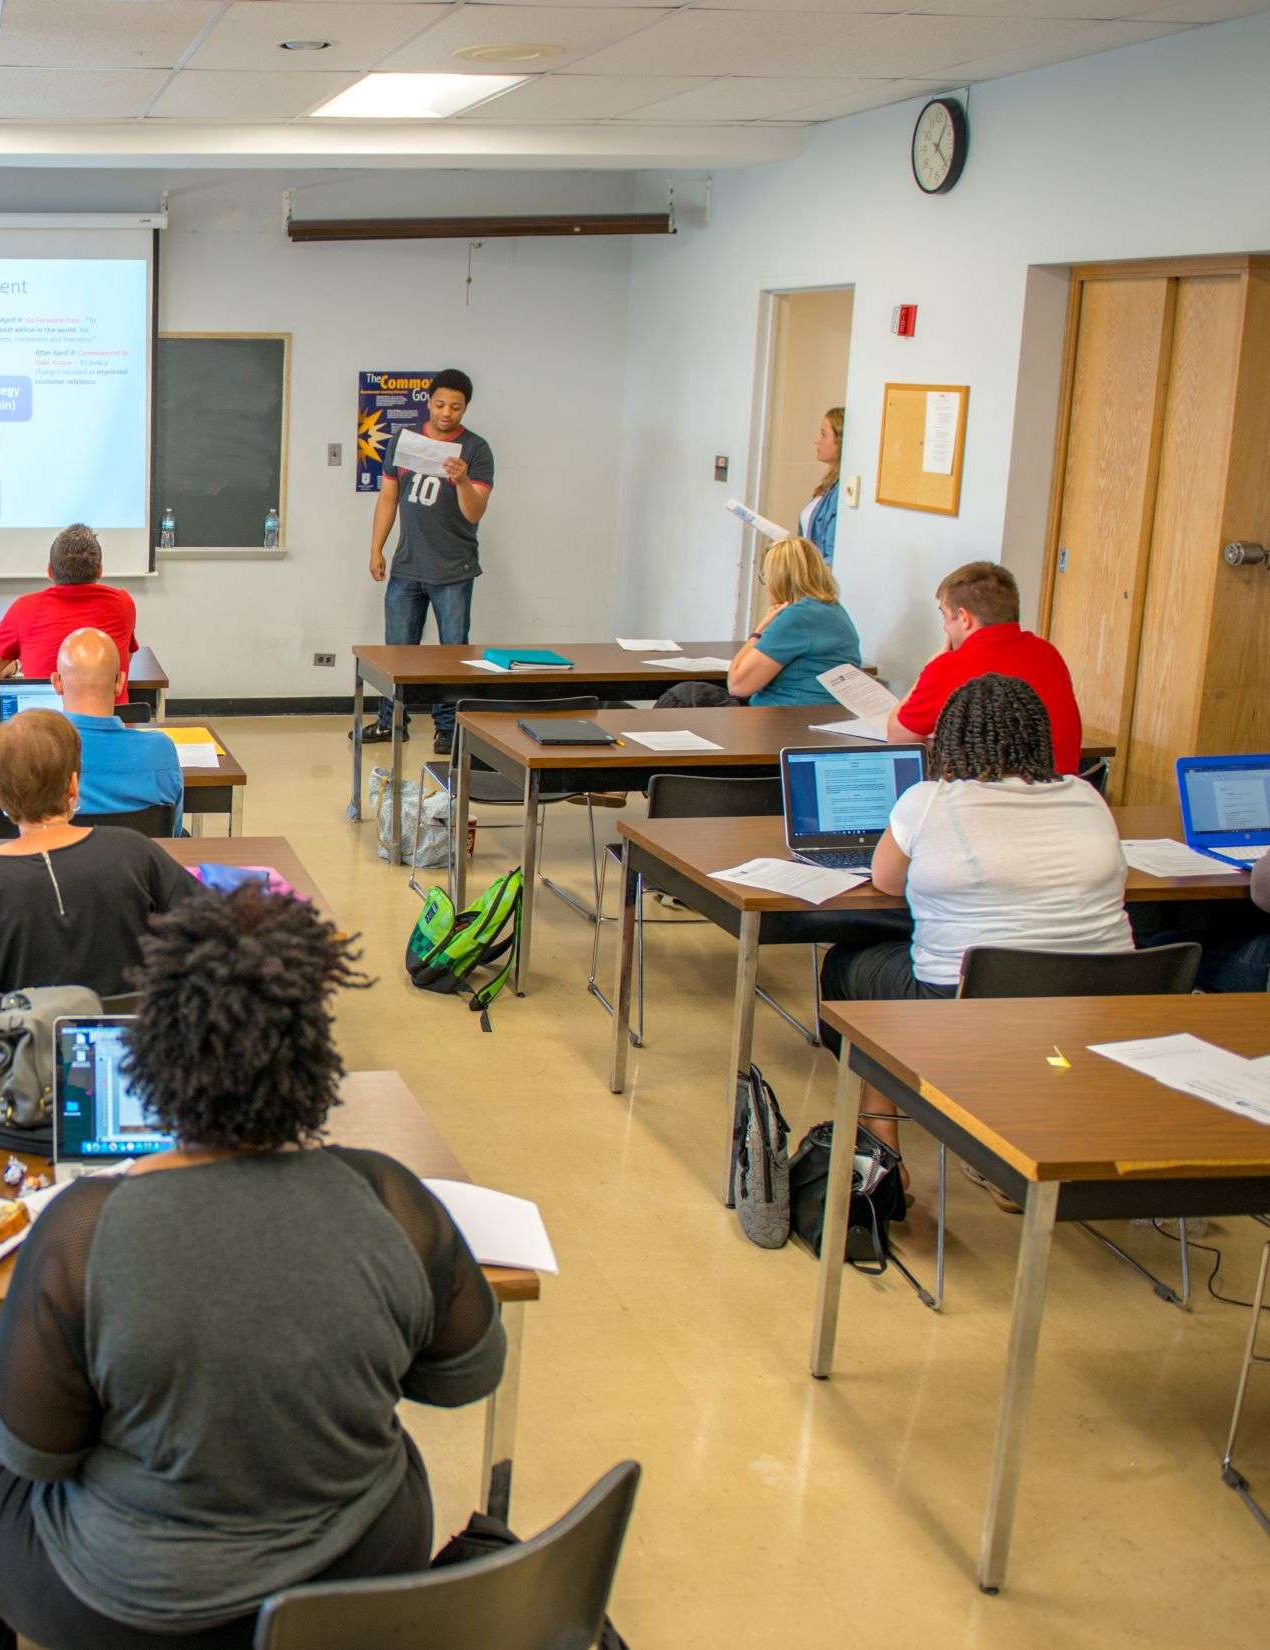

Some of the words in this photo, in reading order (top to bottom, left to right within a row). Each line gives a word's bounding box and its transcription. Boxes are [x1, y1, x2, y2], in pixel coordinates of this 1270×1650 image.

[366, 373, 381, 383] The
[380, 374, 434, 389] Commo
[407, 473, 441, 507] 10
